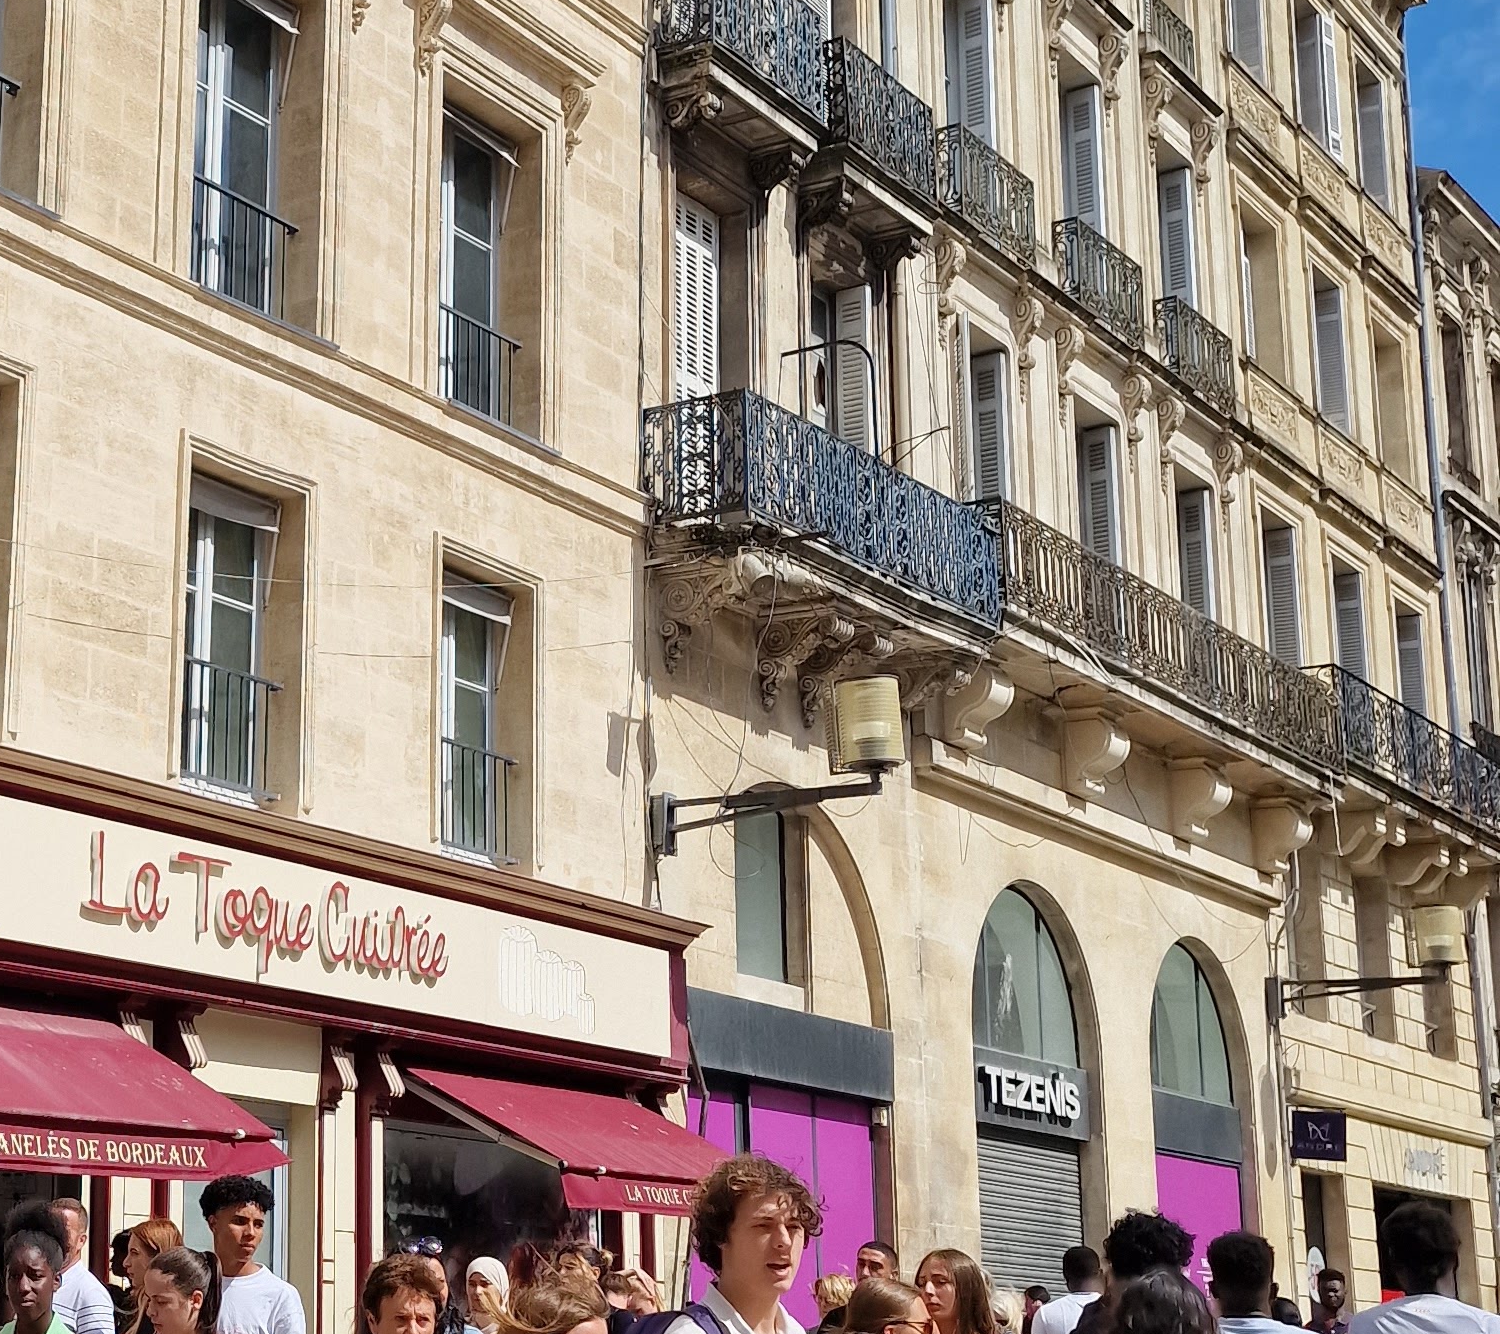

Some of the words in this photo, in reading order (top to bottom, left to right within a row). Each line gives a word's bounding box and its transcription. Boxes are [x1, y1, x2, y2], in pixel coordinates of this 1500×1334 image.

[82, 830, 169, 927] La
[171, 851, 314, 975] Toque
[319, 881, 449, 981] Cuivrée
[984, 1065, 1081, 1120] TEZENIS
[76, 1138, 101, 1161] DE
[106, 1140, 208, 1168] BORDEAUX
[625, 1184, 644, 1203] LA
[643, 1186, 682, 1206] TOQUE
